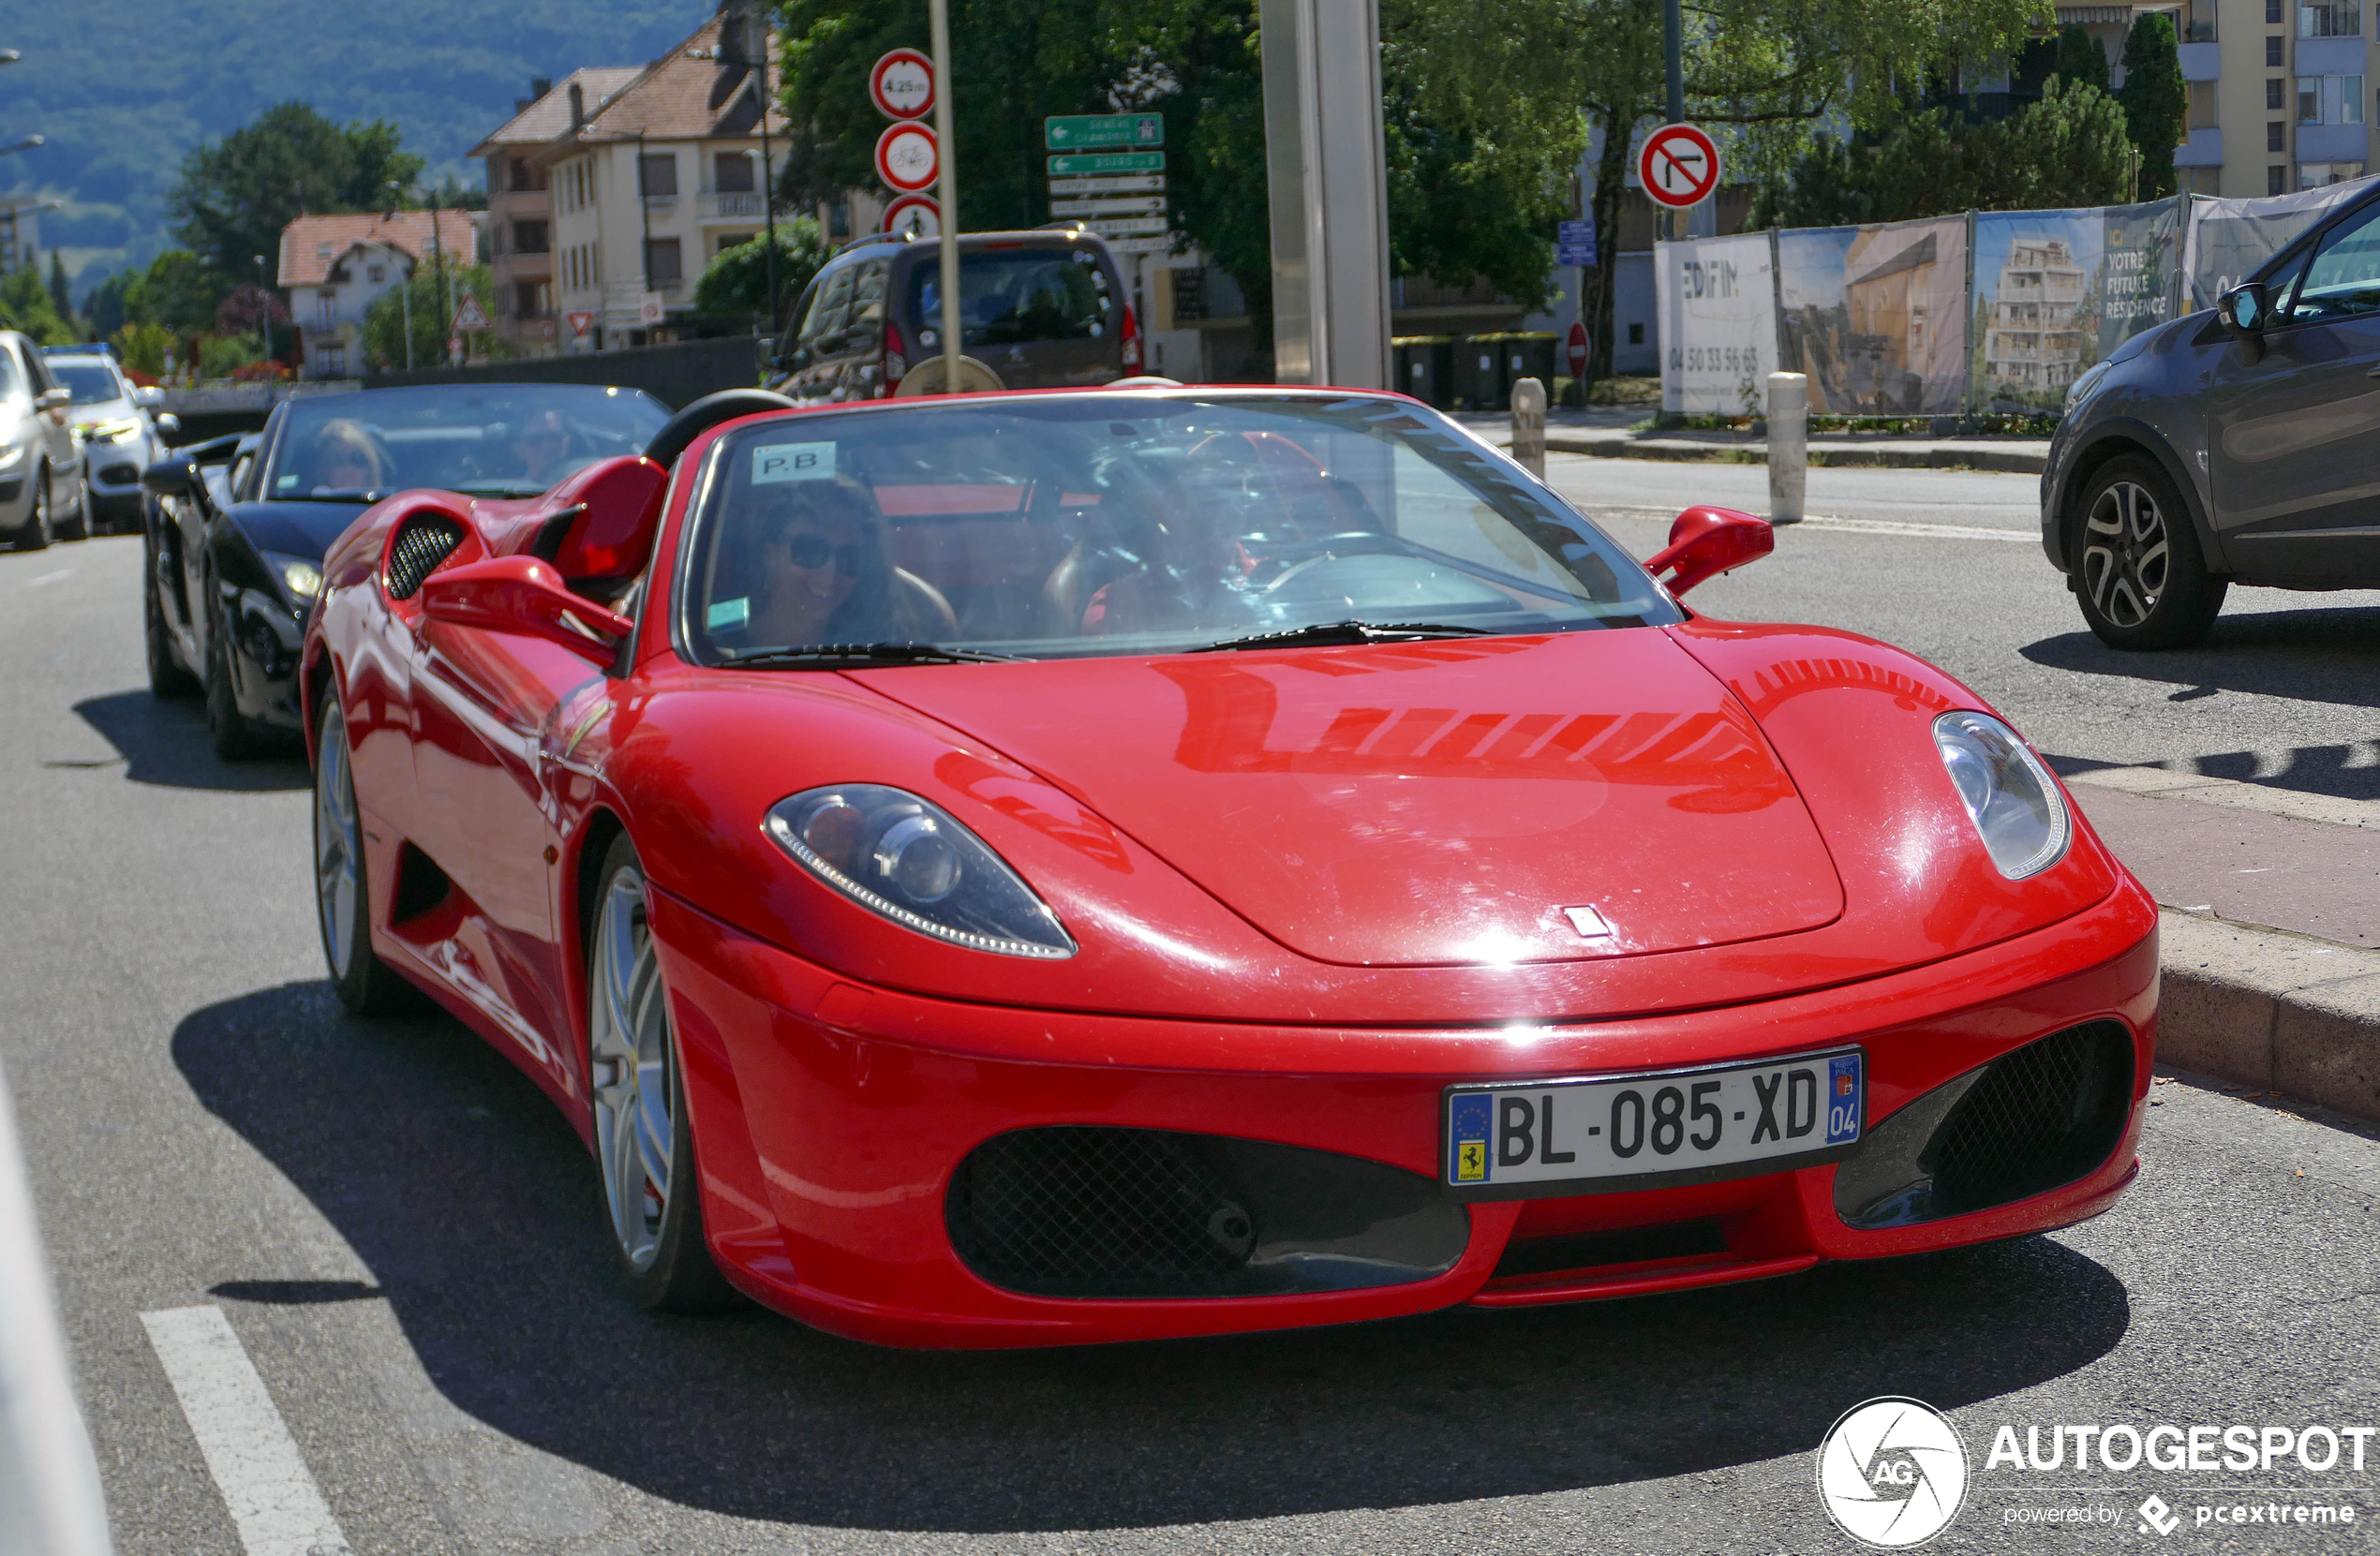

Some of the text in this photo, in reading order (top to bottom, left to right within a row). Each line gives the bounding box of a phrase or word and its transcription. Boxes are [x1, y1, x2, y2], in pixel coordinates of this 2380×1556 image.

[2109, 230, 2124, 246] ICI
[2108, 251, 2144, 270] VOTRE
[1688, 347, 1703, 371] 50
[1707, 347, 1722, 371] 33
[1725, 347, 1740, 371] 56
[1835, 1067, 1854, 1076] PACA
[1830, 1103, 1855, 1135] 04
